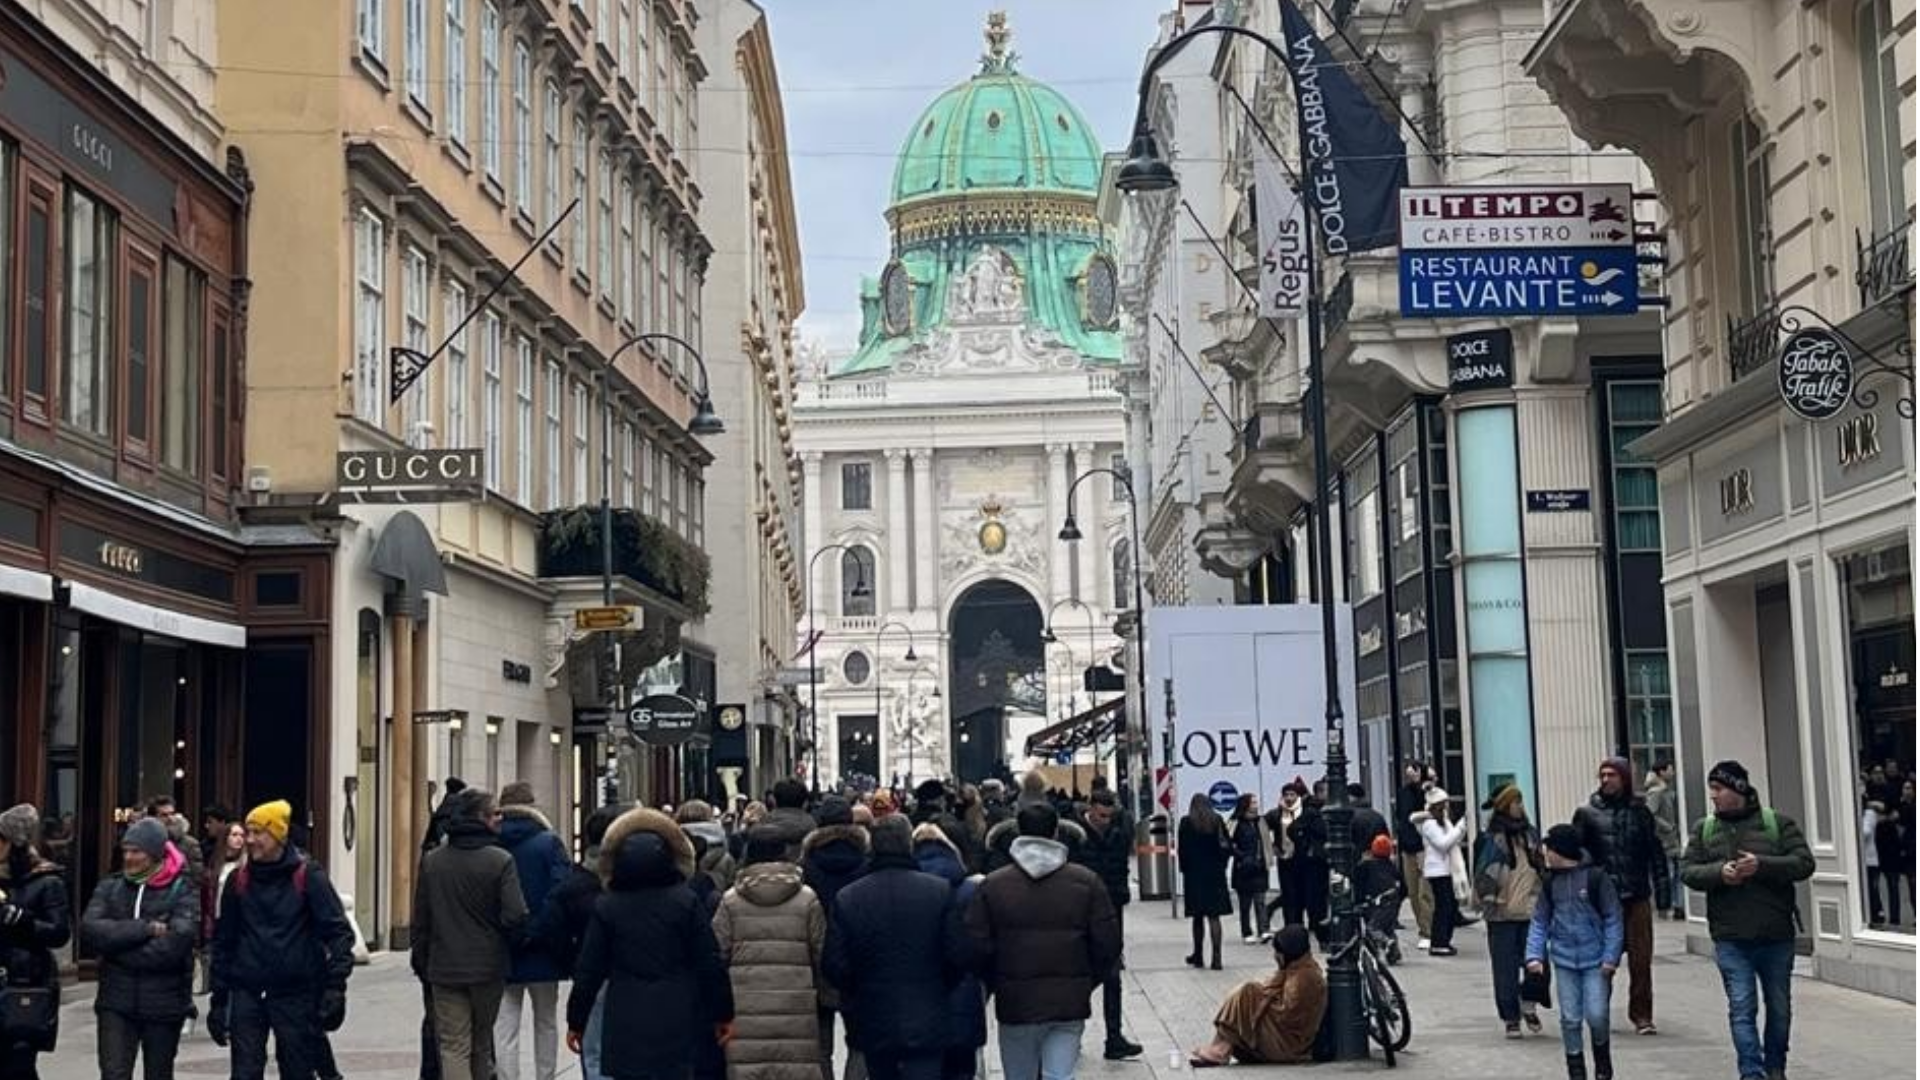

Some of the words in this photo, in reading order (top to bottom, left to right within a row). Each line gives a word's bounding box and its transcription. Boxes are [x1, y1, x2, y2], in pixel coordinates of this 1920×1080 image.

[1293, 33, 1332, 159] GABBANA
[73, 124, 112, 172] GUCCI
[1313, 174, 1349, 255] DOLCE
[1409, 198, 1439, 217] IL
[1445, 195, 1579, 217] TEMPO
[1274, 218, 1309, 310] Regus
[1411, 256, 1574, 278] RESTAURANT
[1411, 279, 1577, 309] LEVANTE
[1784, 345, 1847, 375] Tabak
[1785, 374, 1847, 402] Trafik
[1837, 413, 1882, 467] DIOR
[343, 454, 477, 481] GUCCI
[1162, 727, 1315, 767] LOEWE
